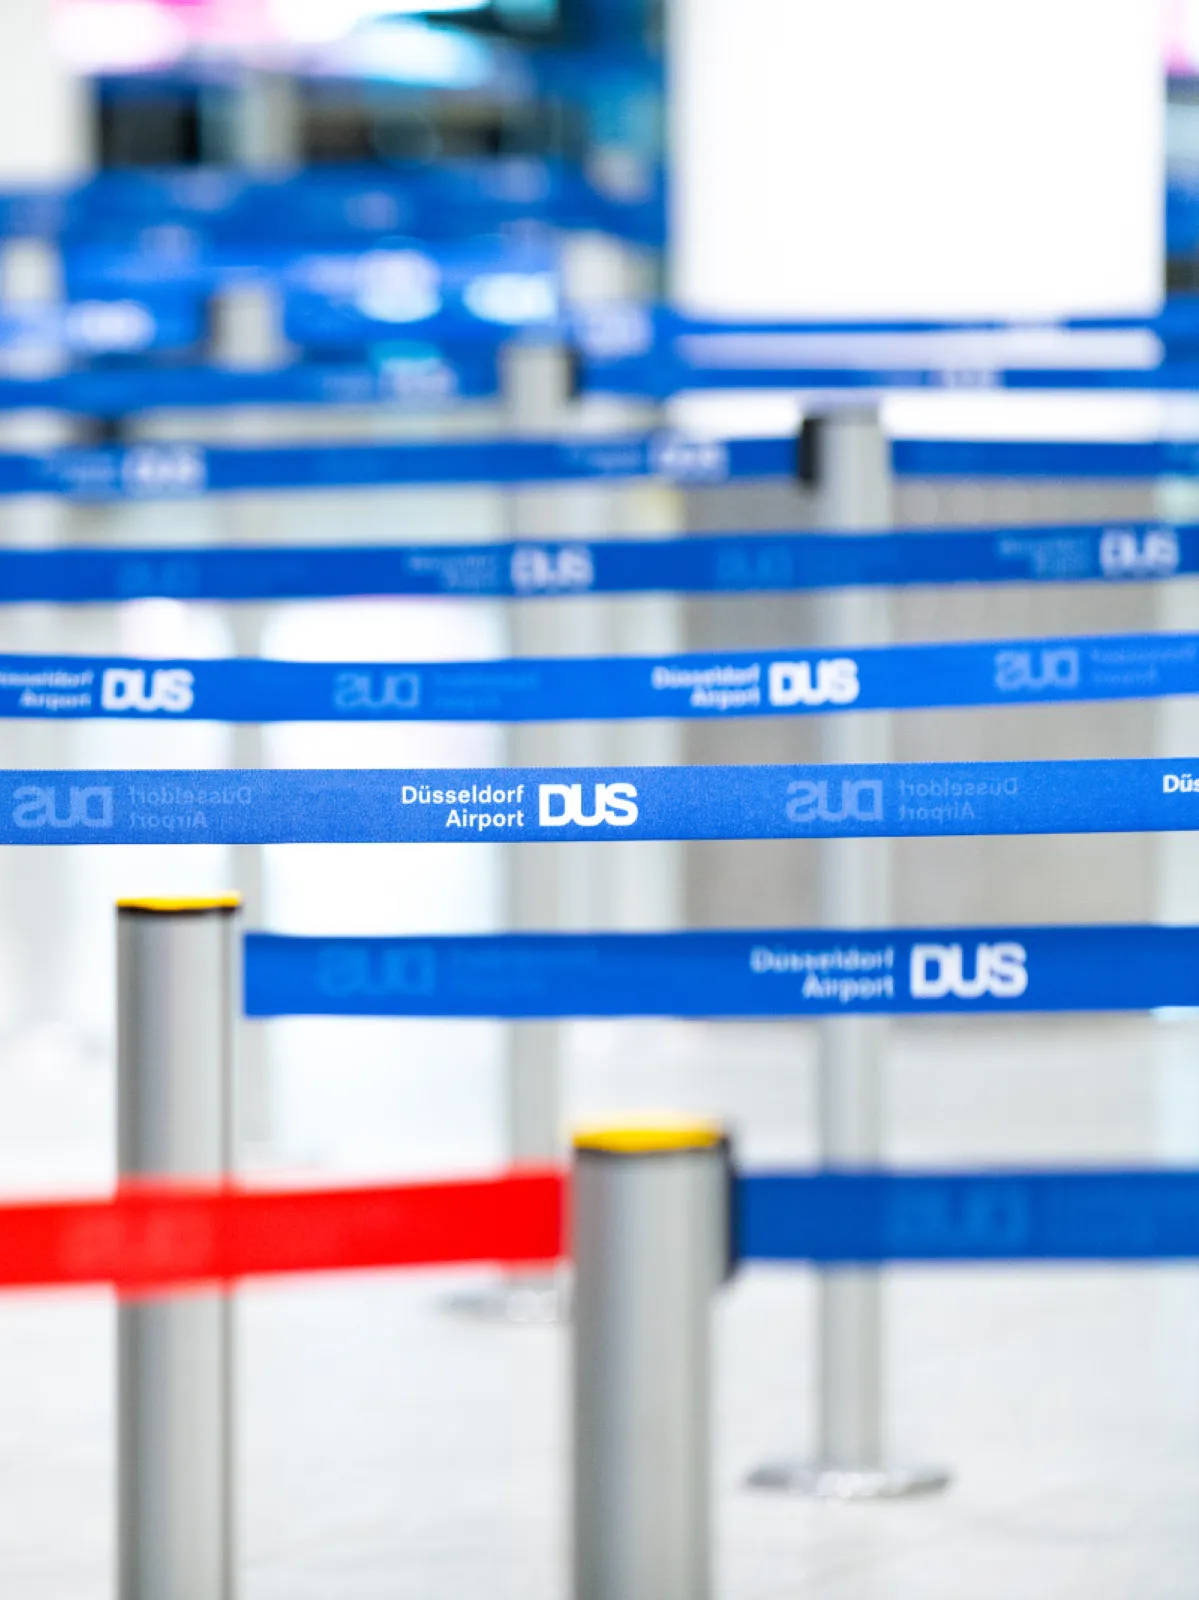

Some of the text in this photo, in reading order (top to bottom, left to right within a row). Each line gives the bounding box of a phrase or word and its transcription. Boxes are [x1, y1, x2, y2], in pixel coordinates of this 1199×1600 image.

[101, 668, 195, 712] DUS
[768, 658, 861, 707] DUS
[401, 784, 524, 804] Düsseldorf
[539, 782, 638, 827] DUS
[445, 809, 524, 831] Airport
[803, 974, 894, 1002] Airport
[910, 942, 1028, 998] DUS
